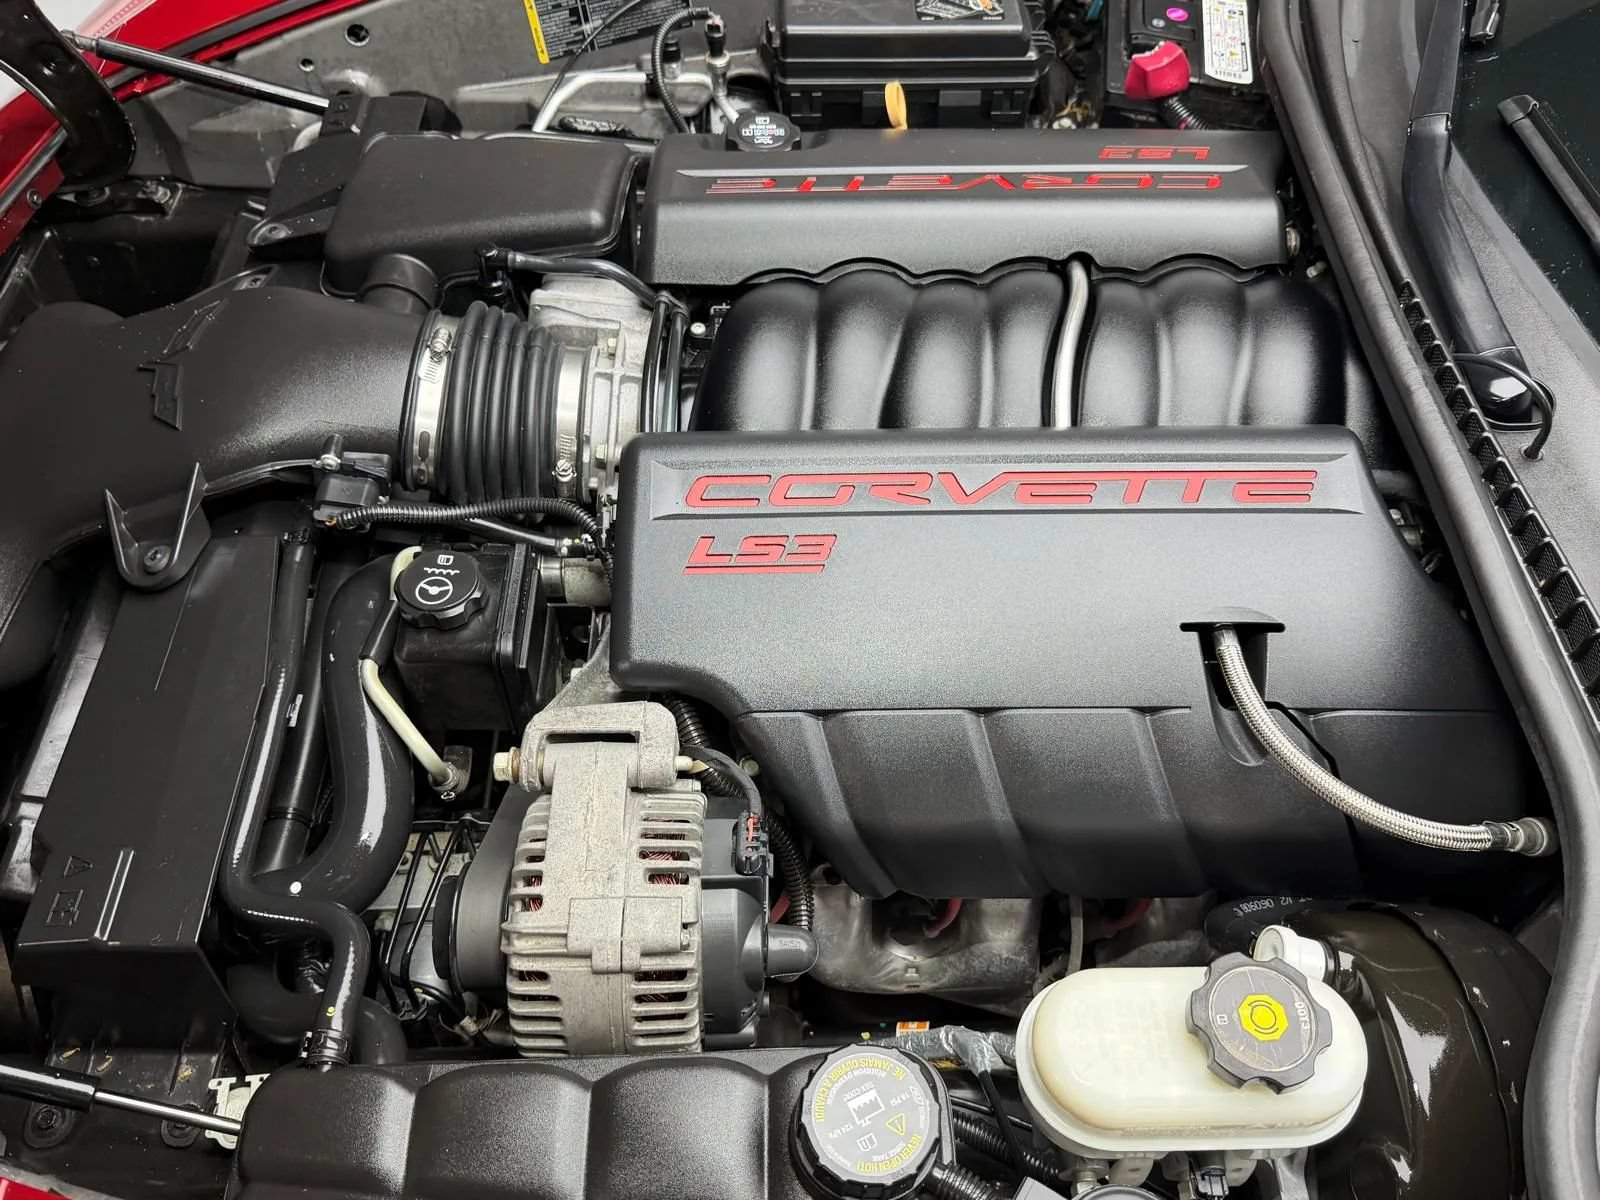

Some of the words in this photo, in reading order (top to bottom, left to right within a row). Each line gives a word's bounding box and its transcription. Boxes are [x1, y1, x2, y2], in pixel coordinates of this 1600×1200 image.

[1099, 146, 1209, 160] LS3
[706, 174, 1222, 194] CORVETTE
[685, 470, 1317, 508] CORVETTE
[686, 534, 837, 569] LS3
[829, 1058, 858, 1081] OUVRIR
[859, 1057, 895, 1072] JAMAIS
[892, 1067, 906, 1080] NE
[815, 1087, 828, 1123] CHAUD!
[898, 1133, 921, 1159] NEVER
[856, 1161, 877, 1172] HOT!
[880, 1154, 902, 1171] OPEN
